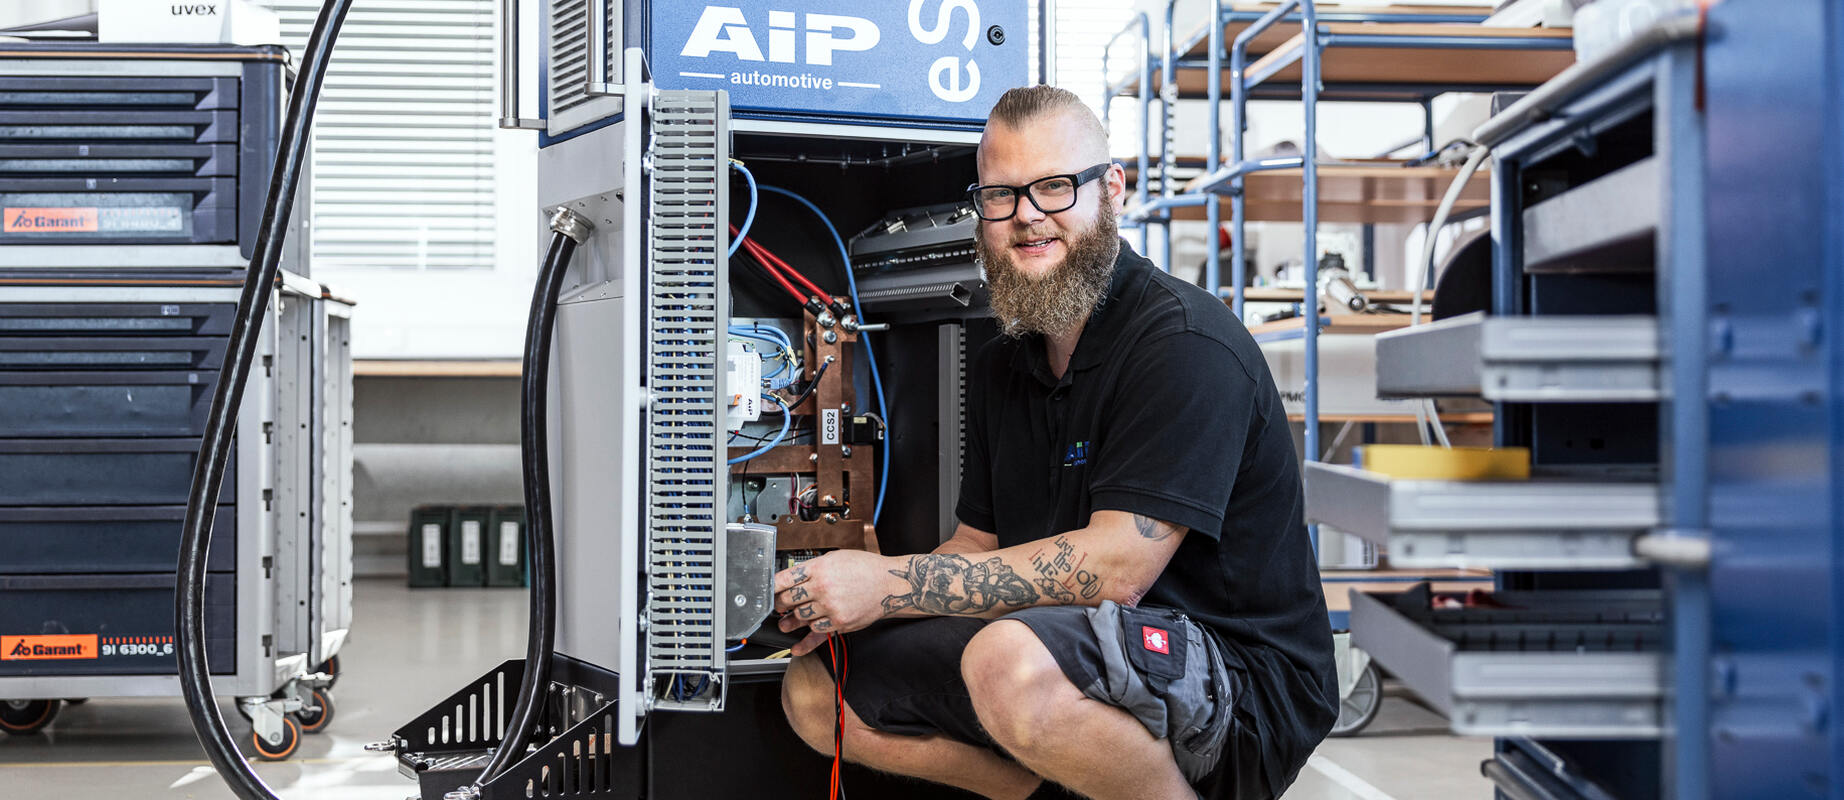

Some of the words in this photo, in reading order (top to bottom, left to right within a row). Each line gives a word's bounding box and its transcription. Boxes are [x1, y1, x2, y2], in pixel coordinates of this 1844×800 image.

[171, 4, 217, 16] uvex
[730, 70, 833, 90] automotive
[34, 216, 86, 228] Garant
[826, 411, 836, 441] CCS2
[32, 644, 83, 656] Garant
[119, 643, 174, 657] 6300_6
